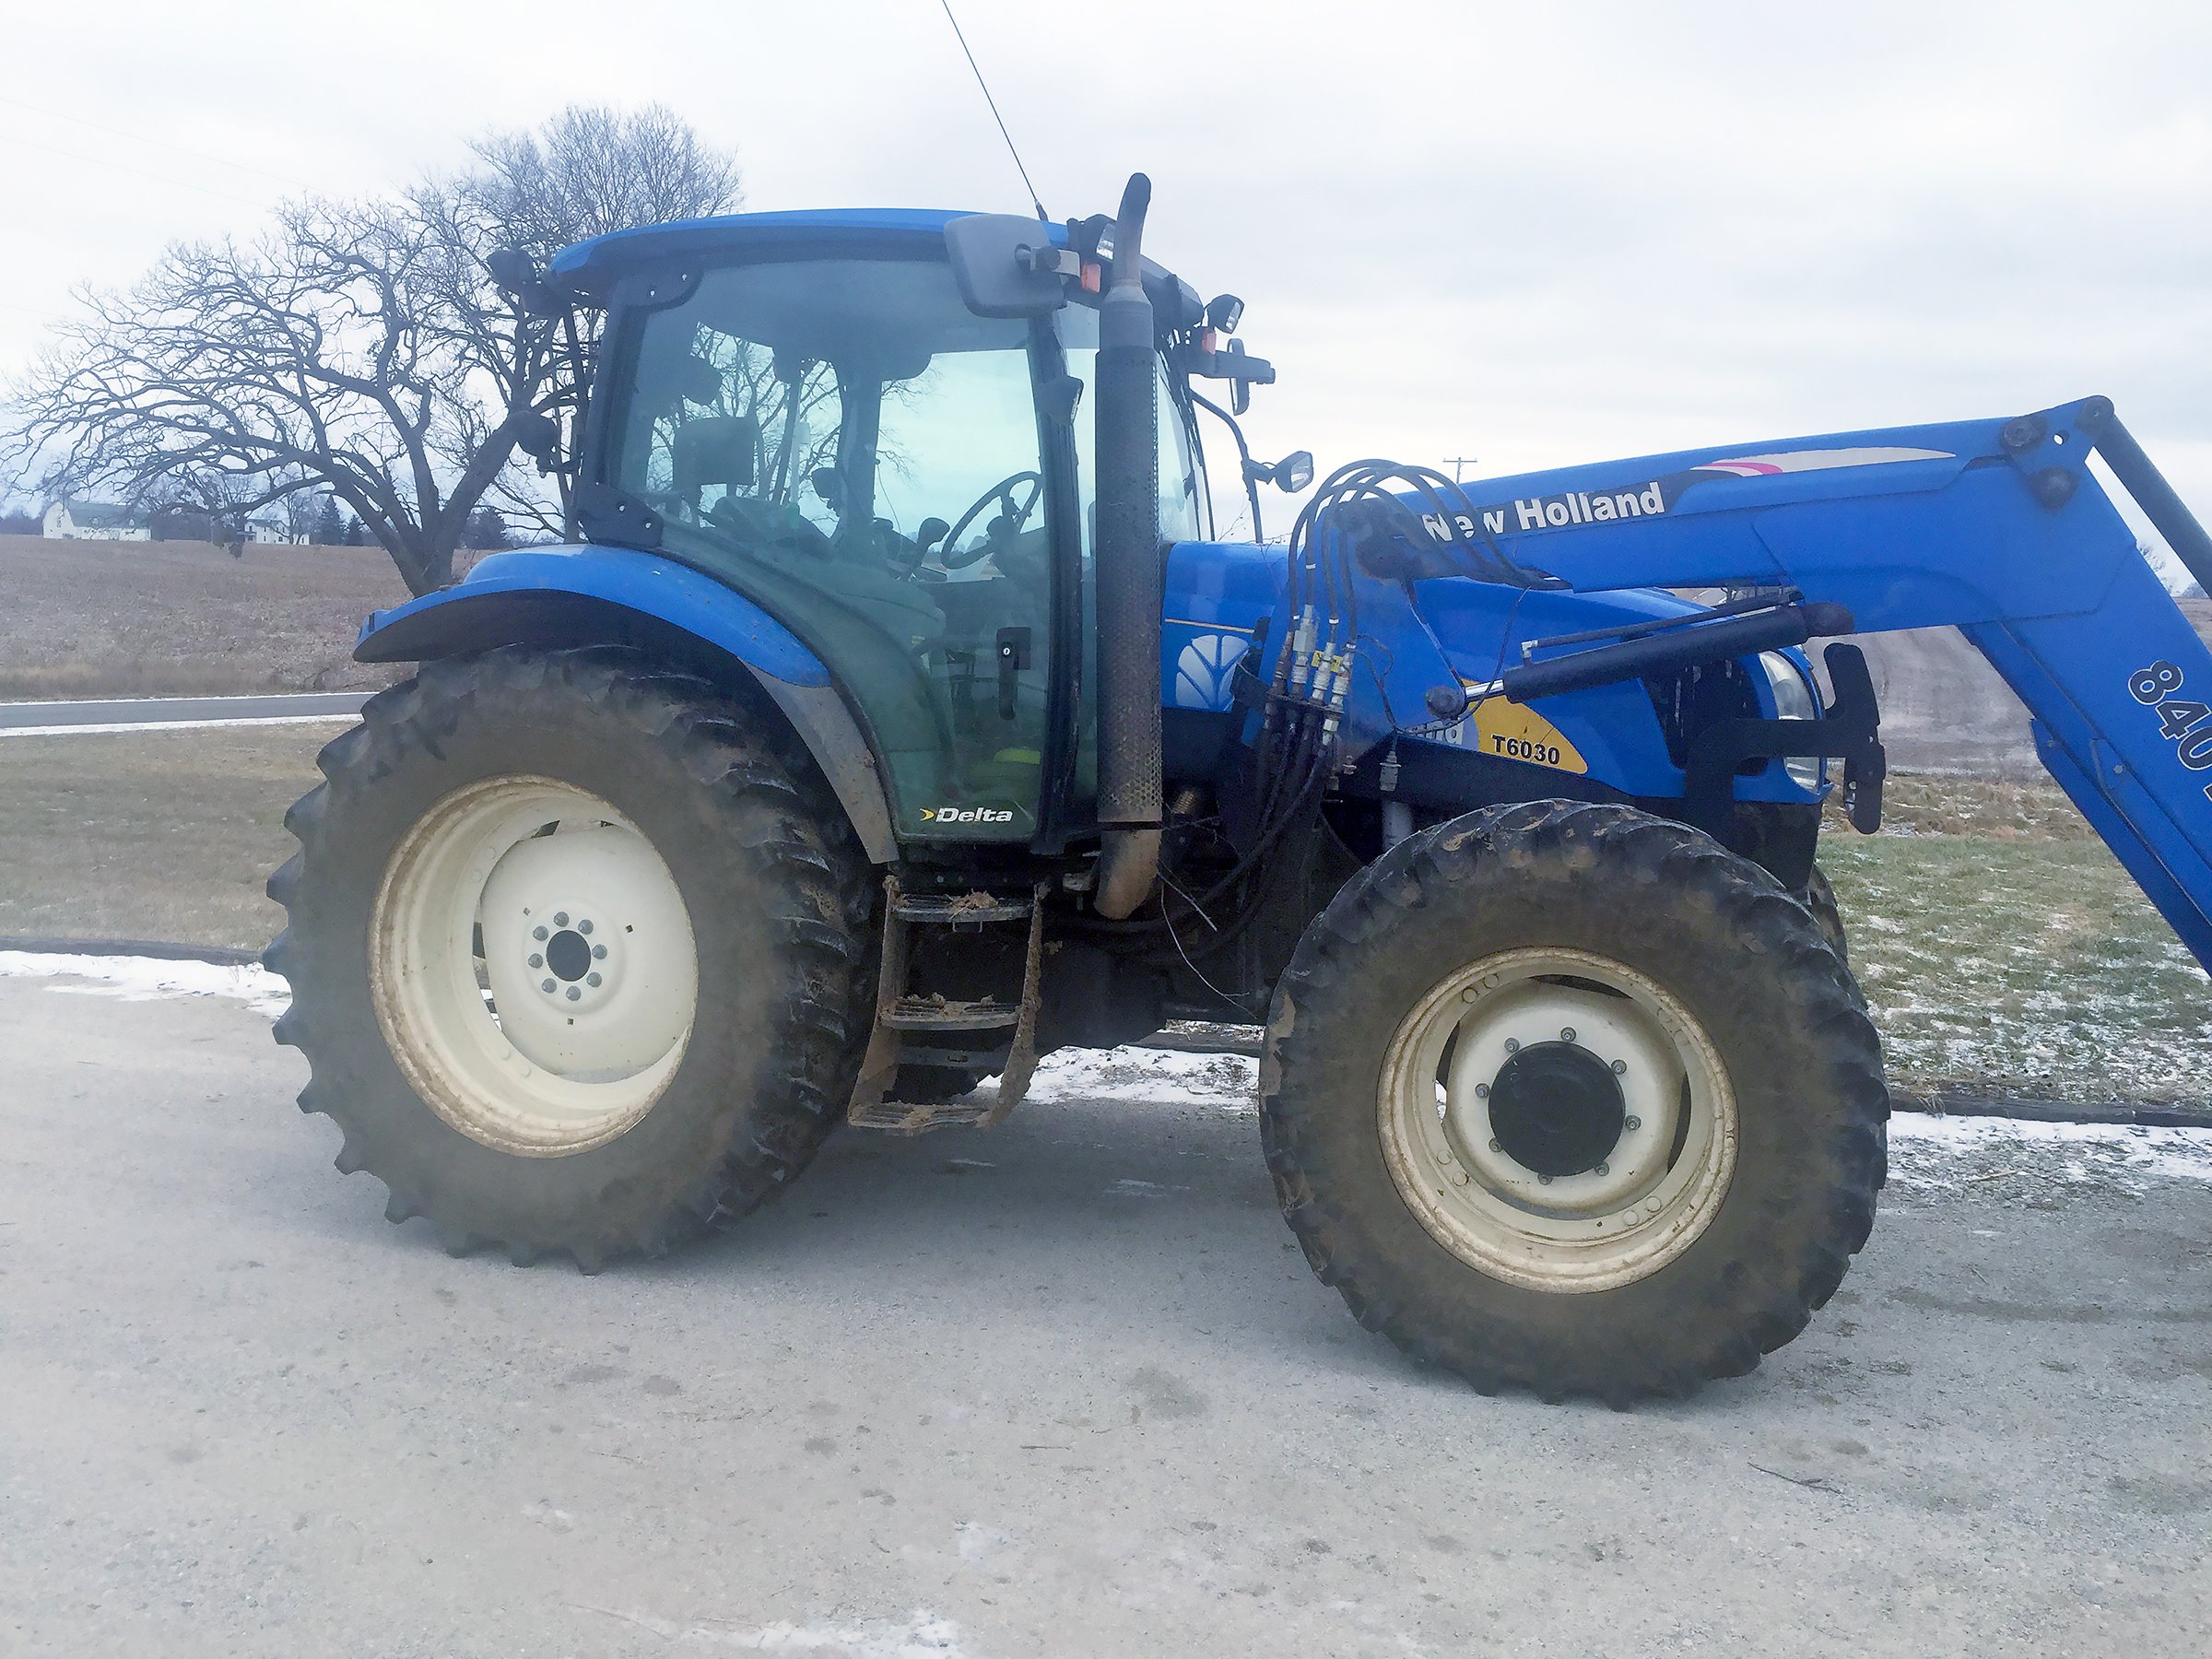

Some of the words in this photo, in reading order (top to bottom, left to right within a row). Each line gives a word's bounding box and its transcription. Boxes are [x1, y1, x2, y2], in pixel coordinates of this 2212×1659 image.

[1514, 481, 1665, 531] Holland
[1491, 734, 1560, 765] T6030
[2128, 659, 2212, 802] 840
[935, 806, 1013, 823] Delta
